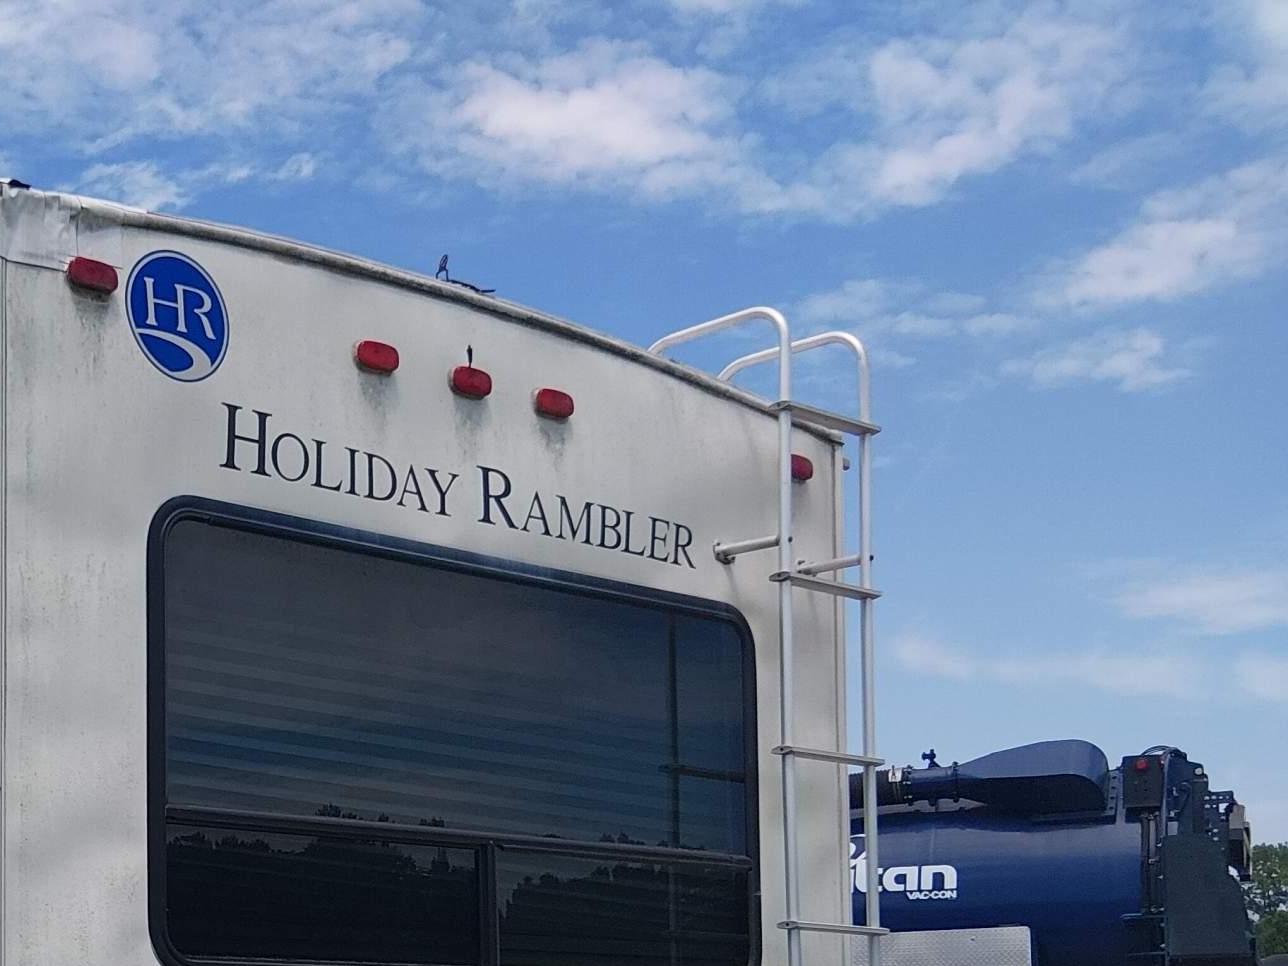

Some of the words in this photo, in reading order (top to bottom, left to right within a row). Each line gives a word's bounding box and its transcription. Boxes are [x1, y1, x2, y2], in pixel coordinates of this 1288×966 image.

[142, 276, 217, 341] HR
[219, 402, 458, 517] HOLIDAY
[476, 465, 696, 569] RAMBLER
